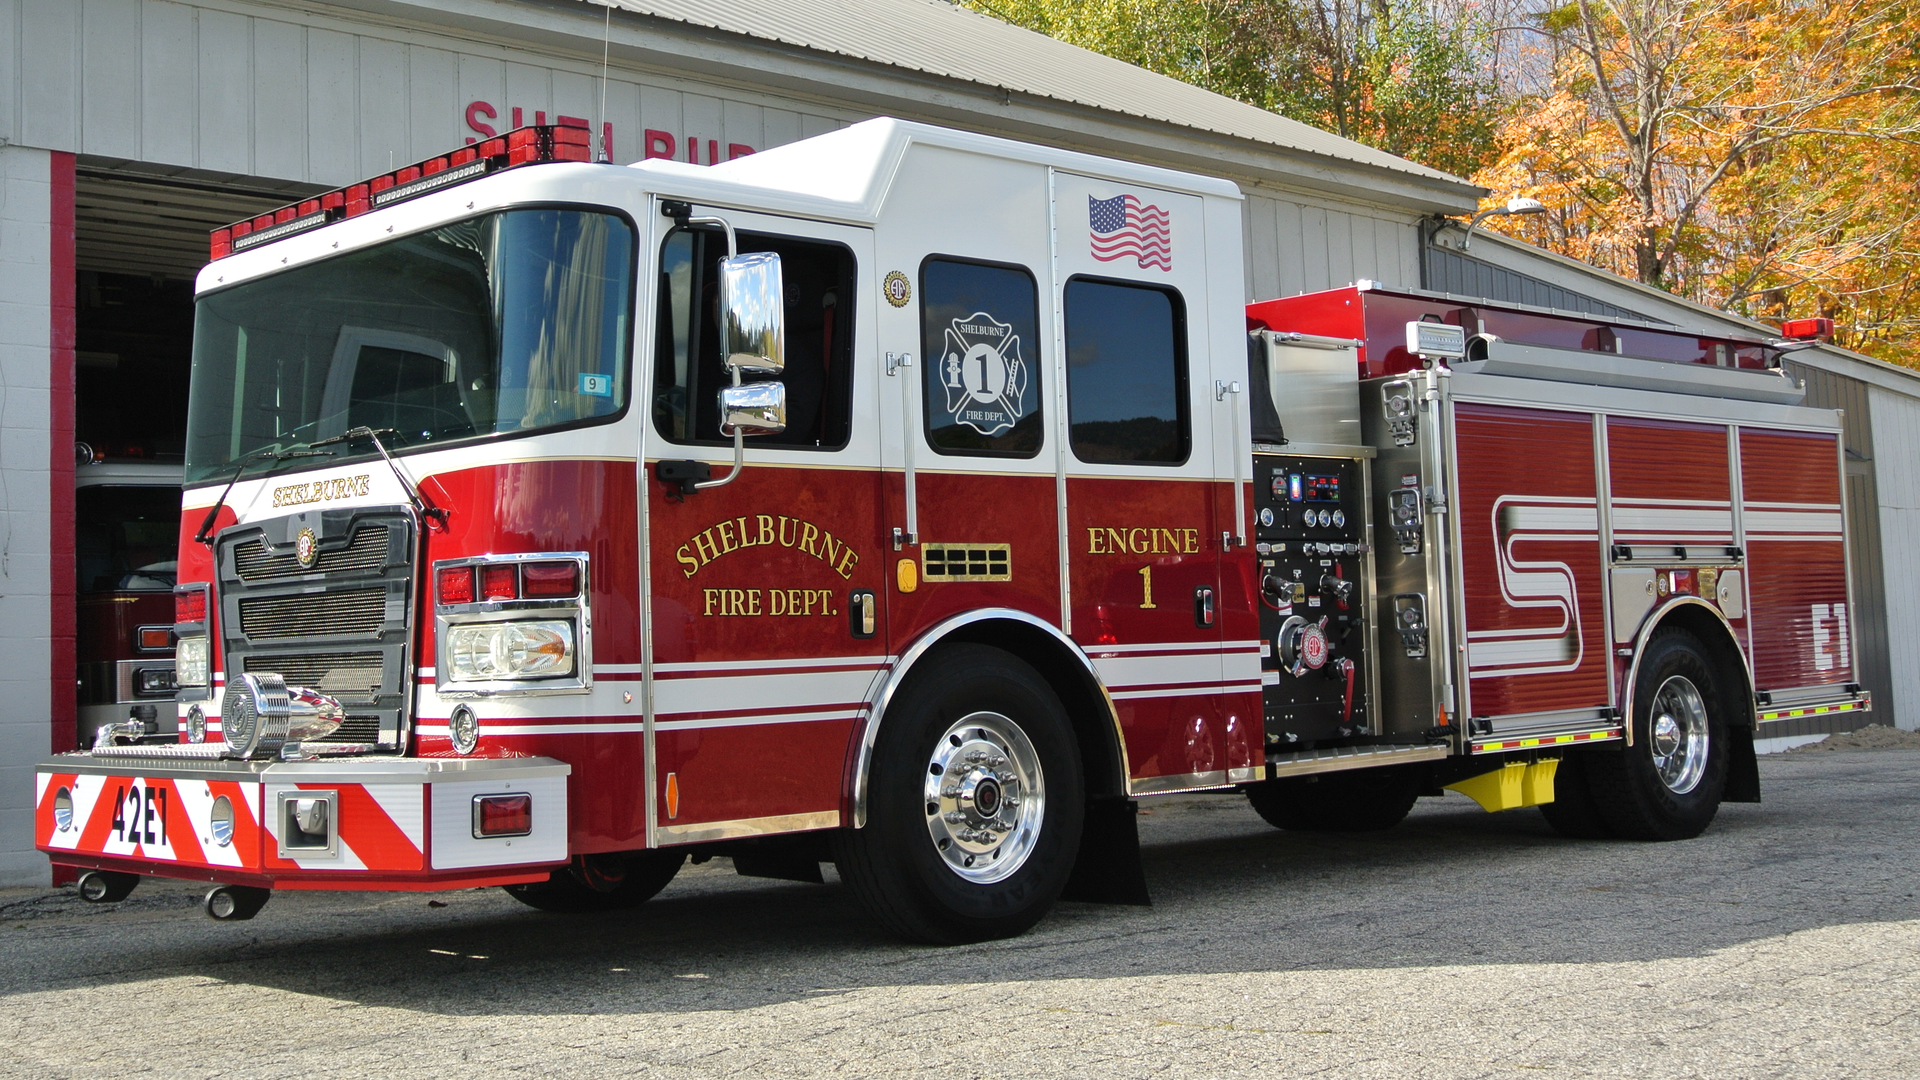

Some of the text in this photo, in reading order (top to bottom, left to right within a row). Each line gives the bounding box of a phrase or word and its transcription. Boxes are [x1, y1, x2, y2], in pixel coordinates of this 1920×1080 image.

[960, 323, 1005, 337] SHELBURNE
[589, 377, 597, 390] 9
[975, 353, 993, 394] 1
[966, 410, 1005, 422] FIRE DEPT.
[272, 474, 370, 508] SHELBURNE
[675, 513, 860, 581] SHELBURNE
[1086, 527, 1200, 554] ENGINE
[703, 588, 838, 616] FIRE DEPT.
[1138, 564, 1157, 609] 1
[1811, 603, 1849, 670] E1
[111, 785, 167, 846] 42E1
